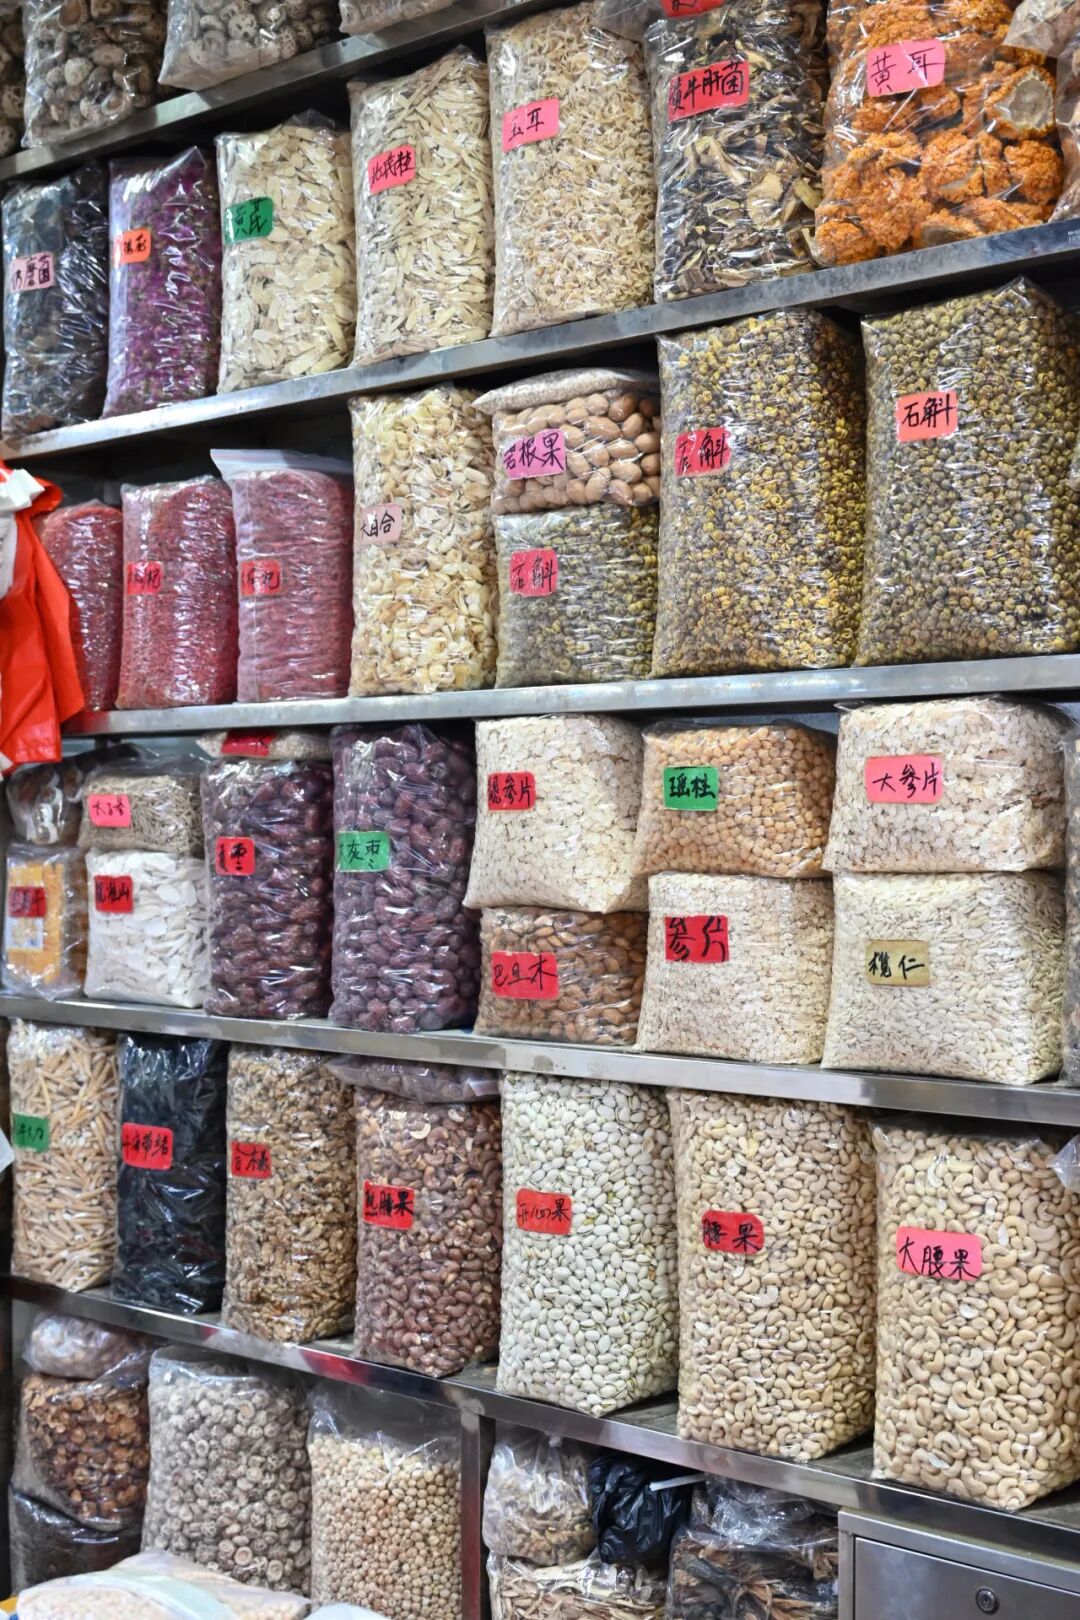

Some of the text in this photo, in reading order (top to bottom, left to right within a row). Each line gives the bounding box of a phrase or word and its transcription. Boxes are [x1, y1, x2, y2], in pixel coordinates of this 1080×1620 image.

[871, 47, 945, 94] 黄耳
[493, 953, 559, 991] 巴旦木
[702, 1218, 763, 1252] 腰果
[898, 1236, 978, 1281] 大腰果
